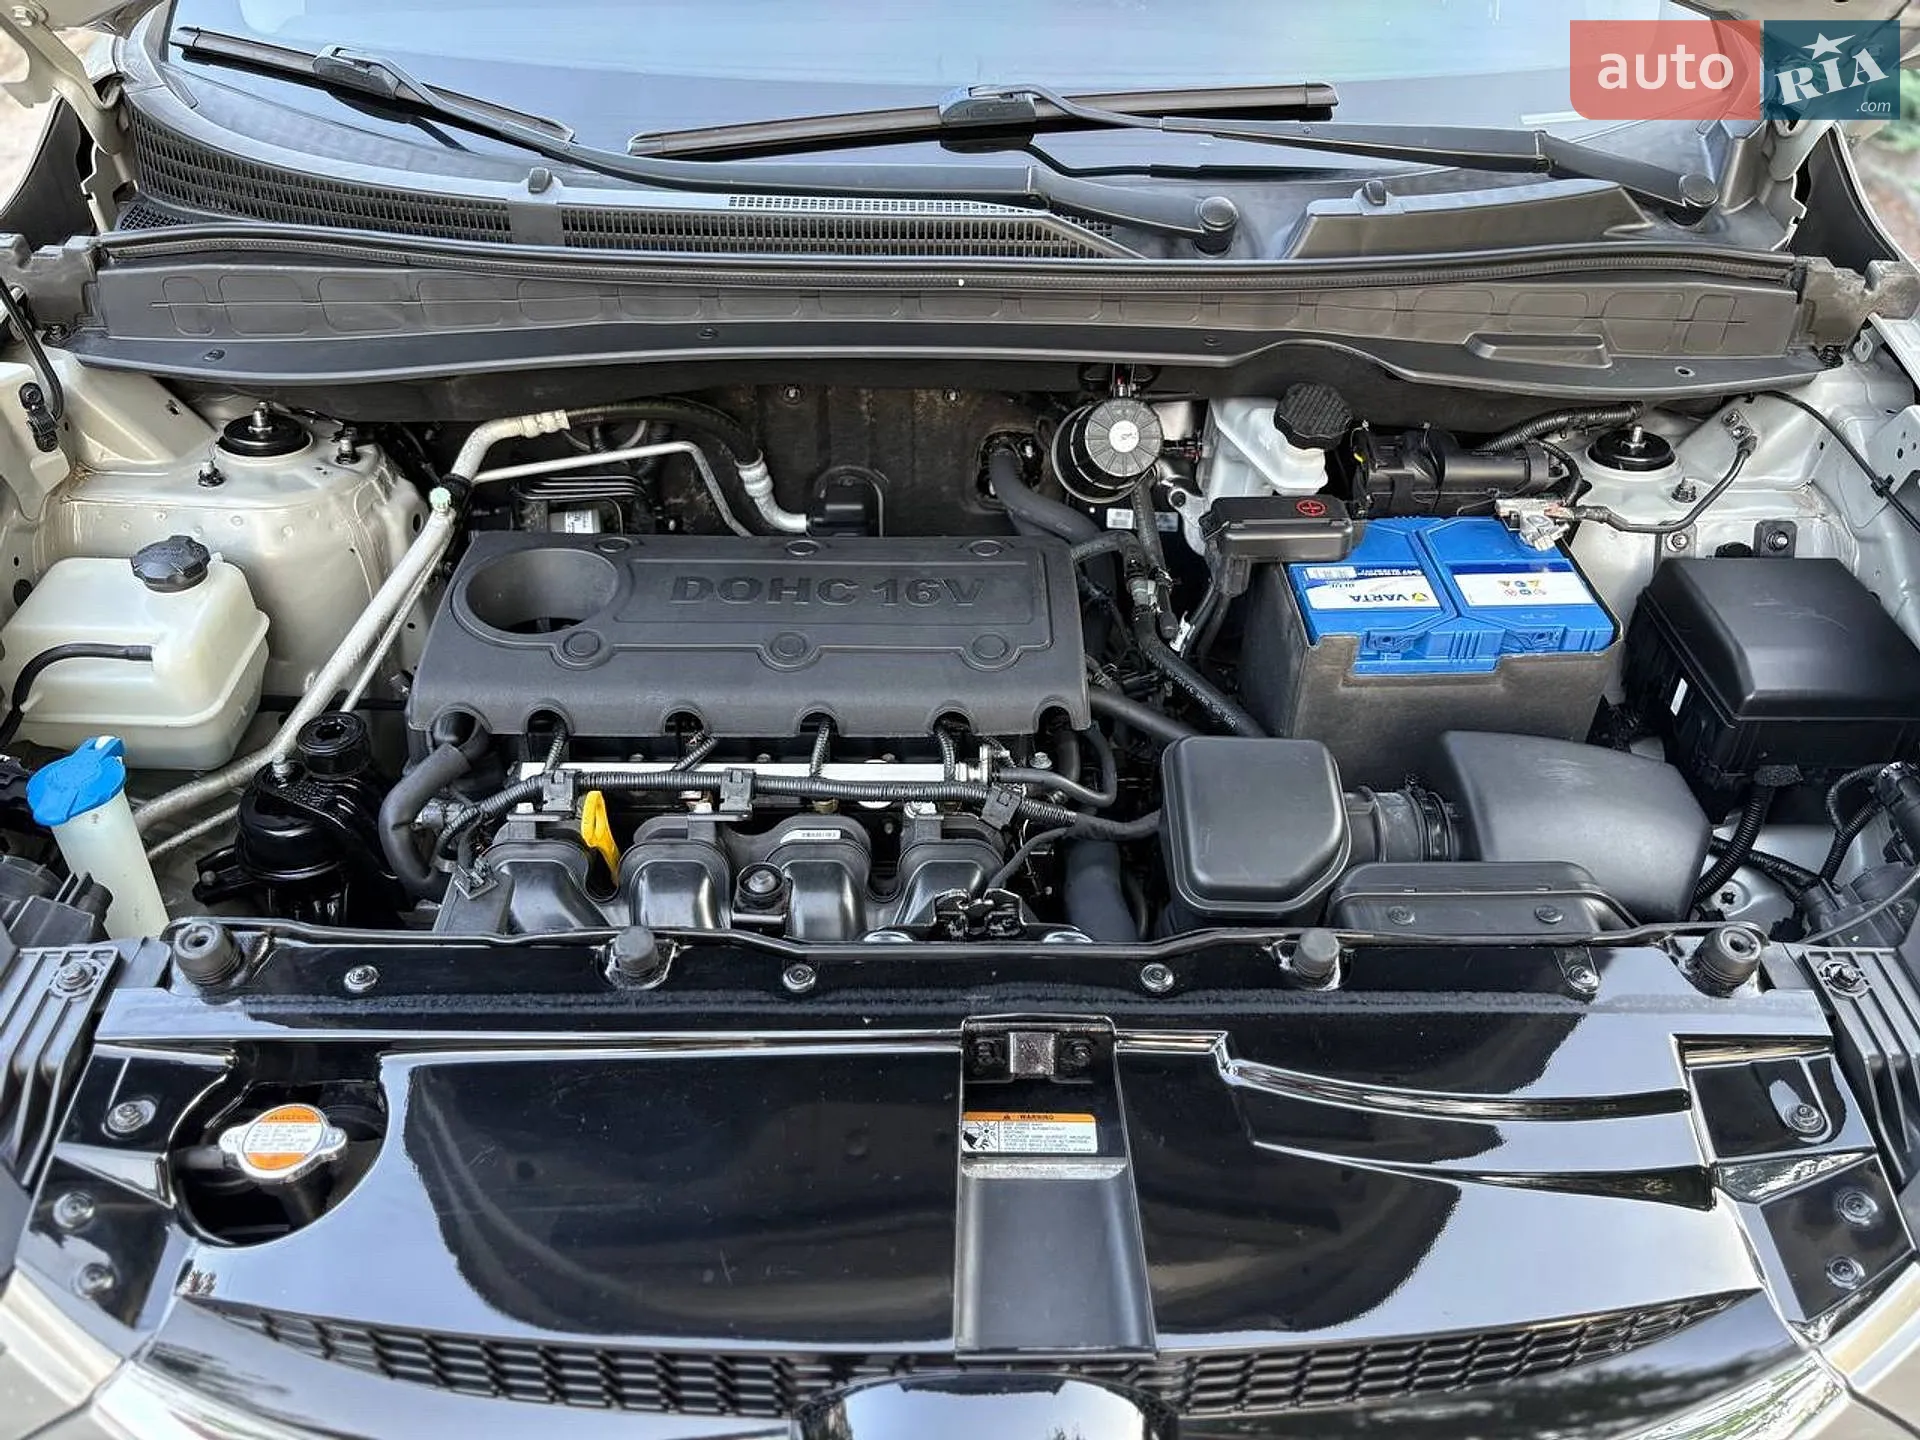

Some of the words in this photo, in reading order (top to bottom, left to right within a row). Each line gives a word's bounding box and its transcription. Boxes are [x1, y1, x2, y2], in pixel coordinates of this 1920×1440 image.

[670, 576, 859, 606] DOHC
[872, 577, 985, 607] 16V
[1349, 594, 1409, 602] VARTA
